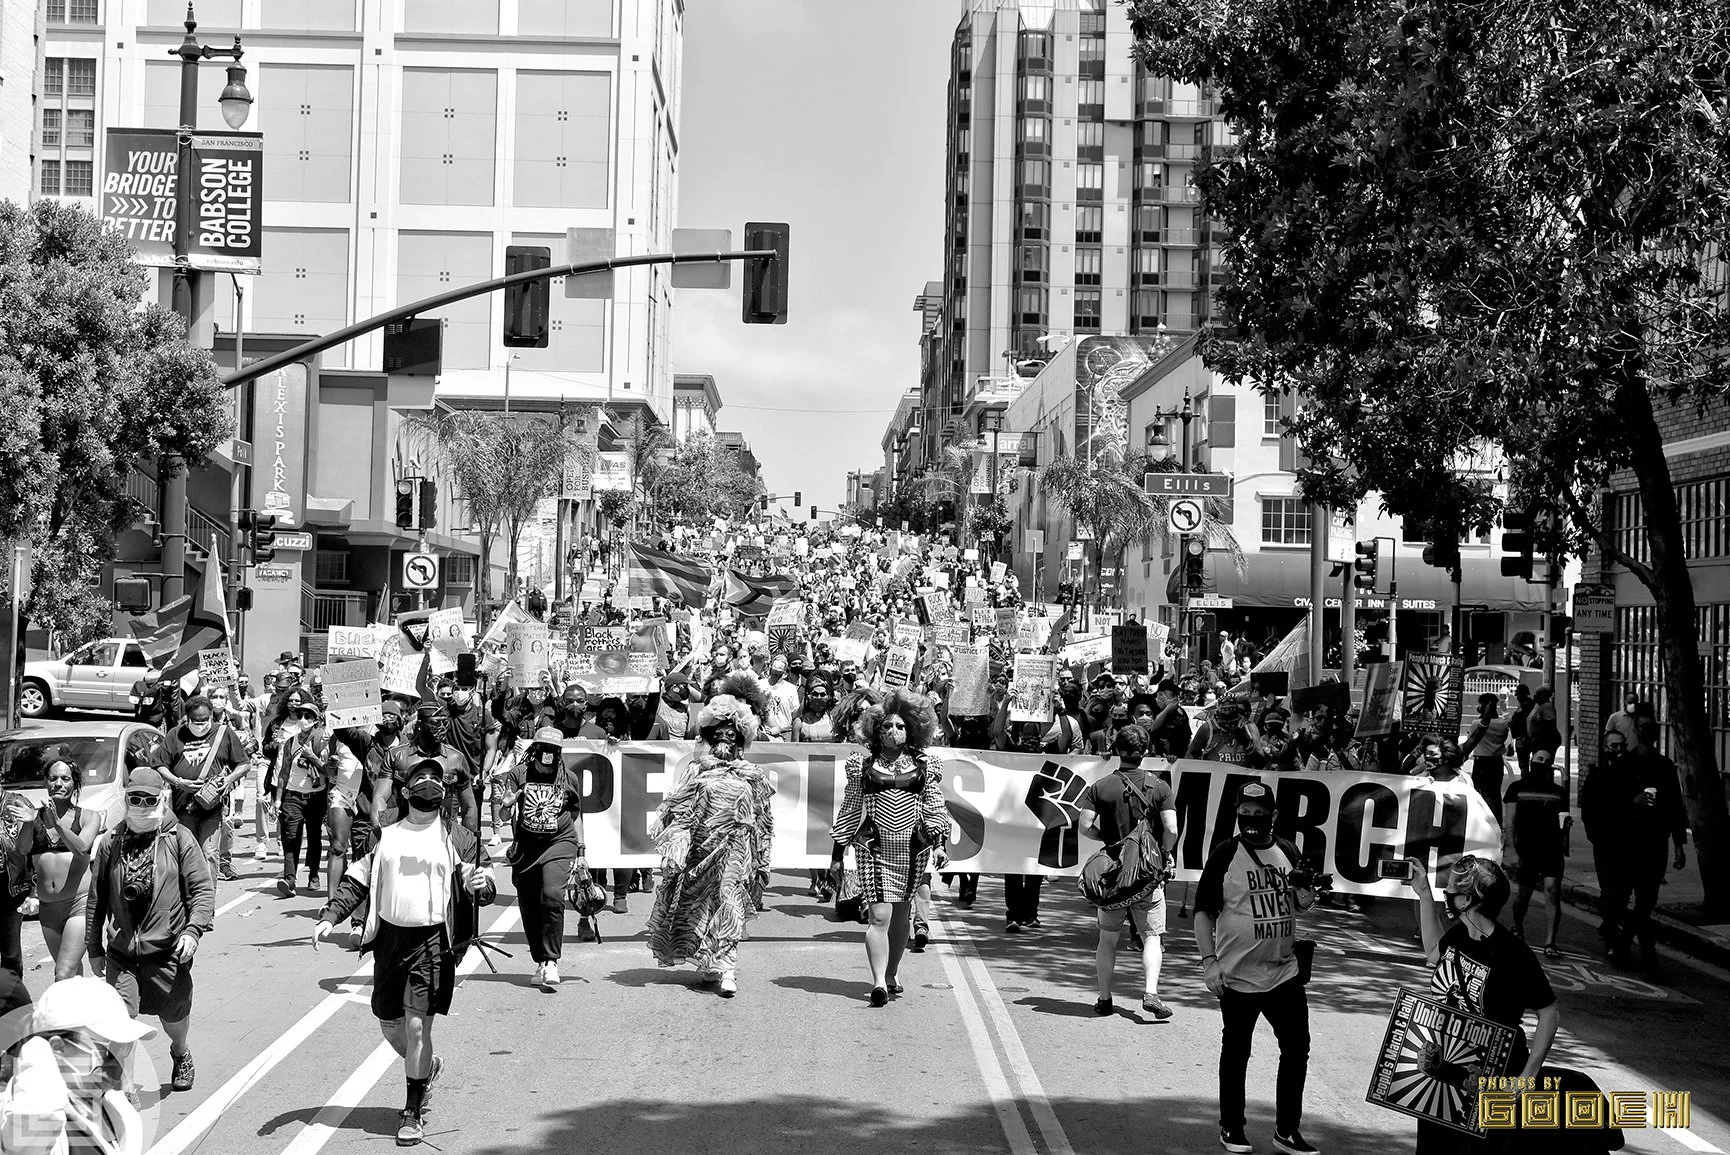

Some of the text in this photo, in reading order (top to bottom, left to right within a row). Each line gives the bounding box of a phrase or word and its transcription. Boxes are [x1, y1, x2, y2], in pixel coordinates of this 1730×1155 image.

[216, 140, 254, 148] FRANCISCO
[127, 151, 178, 174] YOUR
[104, 172, 178, 197] BRIDGE
[152, 197, 177, 219] TO
[200, 158, 227, 247] BABSON
[226, 159, 252, 248] COLLEGE
[101, 215, 176, 242] BETTER
[206, 258, 244, 266] babson.edu
[273, 368, 288, 438] ALEXIS
[273, 441, 286, 492] PARK
[1164, 479, 1210, 491] Ellis
[1196, 599, 1226, 607] ELLIS
[1368, 600, 1384, 608] INN
[1402, 600, 1436, 609] SUITES
[1095, 617, 1111, 626] NOT
[1577, 610, 1612, 618] ANY TIME
[335, 631, 376, 645] BLACK
[584, 627, 613, 639] Black
[1150, 623, 1162, 637] NO
[203, 652, 227, 660] BLACK
[954, 647, 978, 655] JUSTICE
[1430, 655, 1446, 664] March
[1451, 657, 1463, 667] Rally
[206, 675, 231, 683] MATTER
[1450, 668, 1462, 688] Unite
[1449, 690, 1460, 699] to
[1445, 701, 1459, 720] Fight
[1218, 753, 1246, 761] PRIDE
[1246, 867, 1291, 891] BLACK
[1250, 892, 1292, 919] LIVES
[1254, 920, 1293, 940] MATTER
[1469, 978, 1483, 1003] Unite
[1413, 1001, 1493, 1047] Unite to Fight
[1372, 1061, 1395, 1101] People's
[1384, 1027, 1404, 1063] March
[1398, 994, 1417, 1020] Rally
